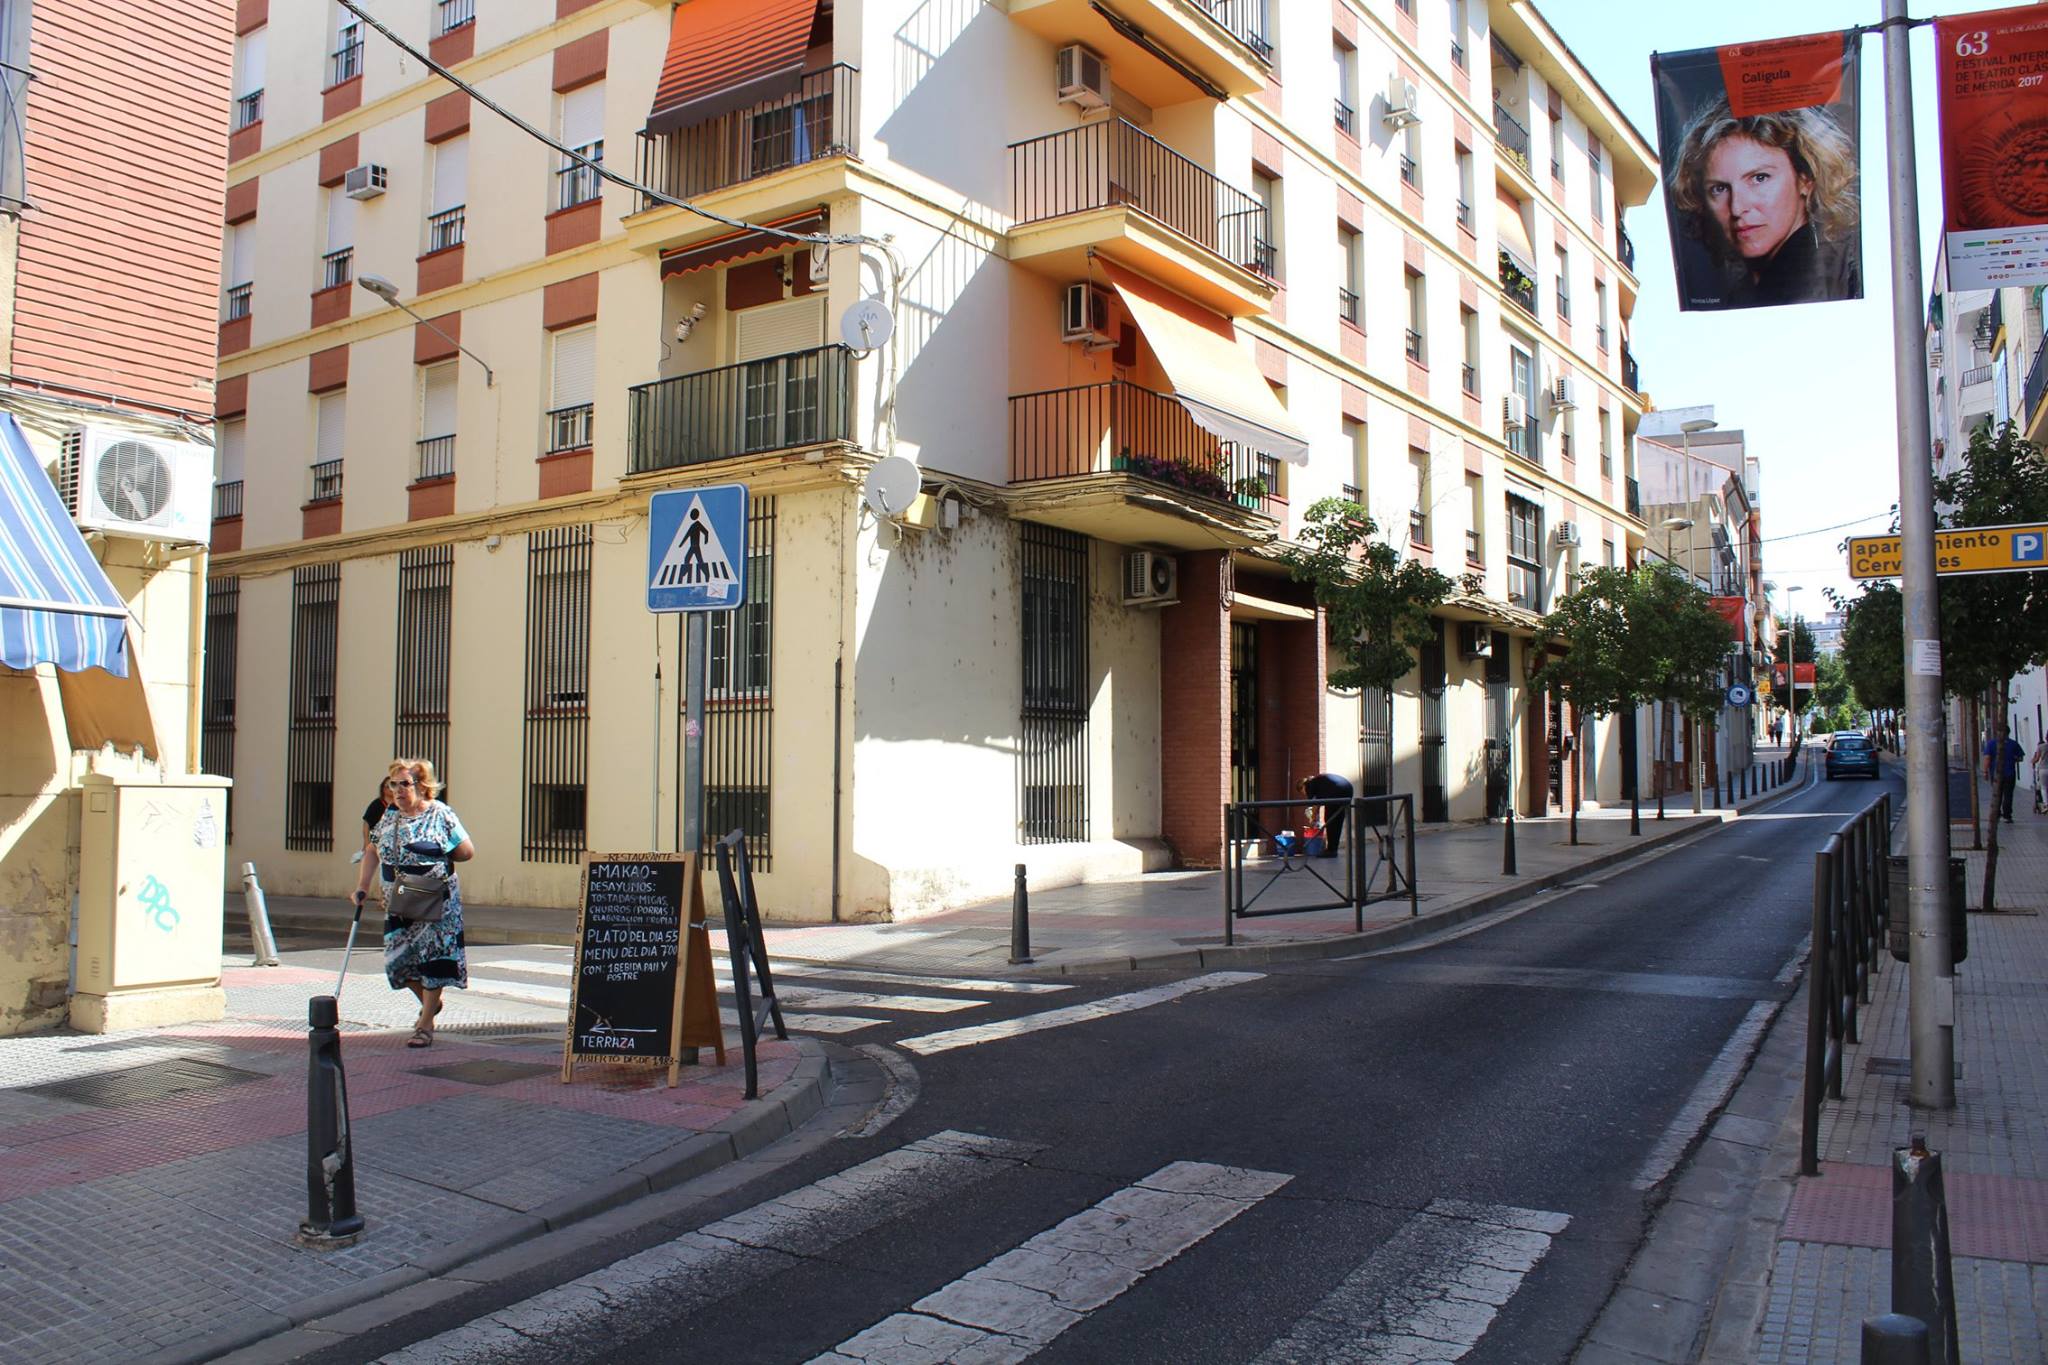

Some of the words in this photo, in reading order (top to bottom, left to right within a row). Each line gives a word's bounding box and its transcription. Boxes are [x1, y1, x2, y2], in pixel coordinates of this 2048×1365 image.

[1956, 31, 1988, 57] 63
[1728, 47, 1740, 57] 63
[1955, 55, 2006, 70] FESTIVAL
[1955, 71, 1969, 82] DE
[1973, 66, 2015, 80] TEATRO
[1955, 83, 1969, 94] DE
[2018, 75, 2044, 88] 2017
[2016, 535, 2038, 560] P
[587, 928, 628, 943] PLATO
[629, 930, 648, 942] DEL
[649, 931, 664, 942] DIA
[585, 947, 618, 960] MENU
[621, 946, 639, 958] DEL
[660, 961, 668, 971] Y
[606, 971, 639, 982] POSTRE
[580, 1035, 635, 1049] TERRAZA
[576, 1054, 620, 1064] ABIERTO
[623, 1055, 651, 1064] DESDE
